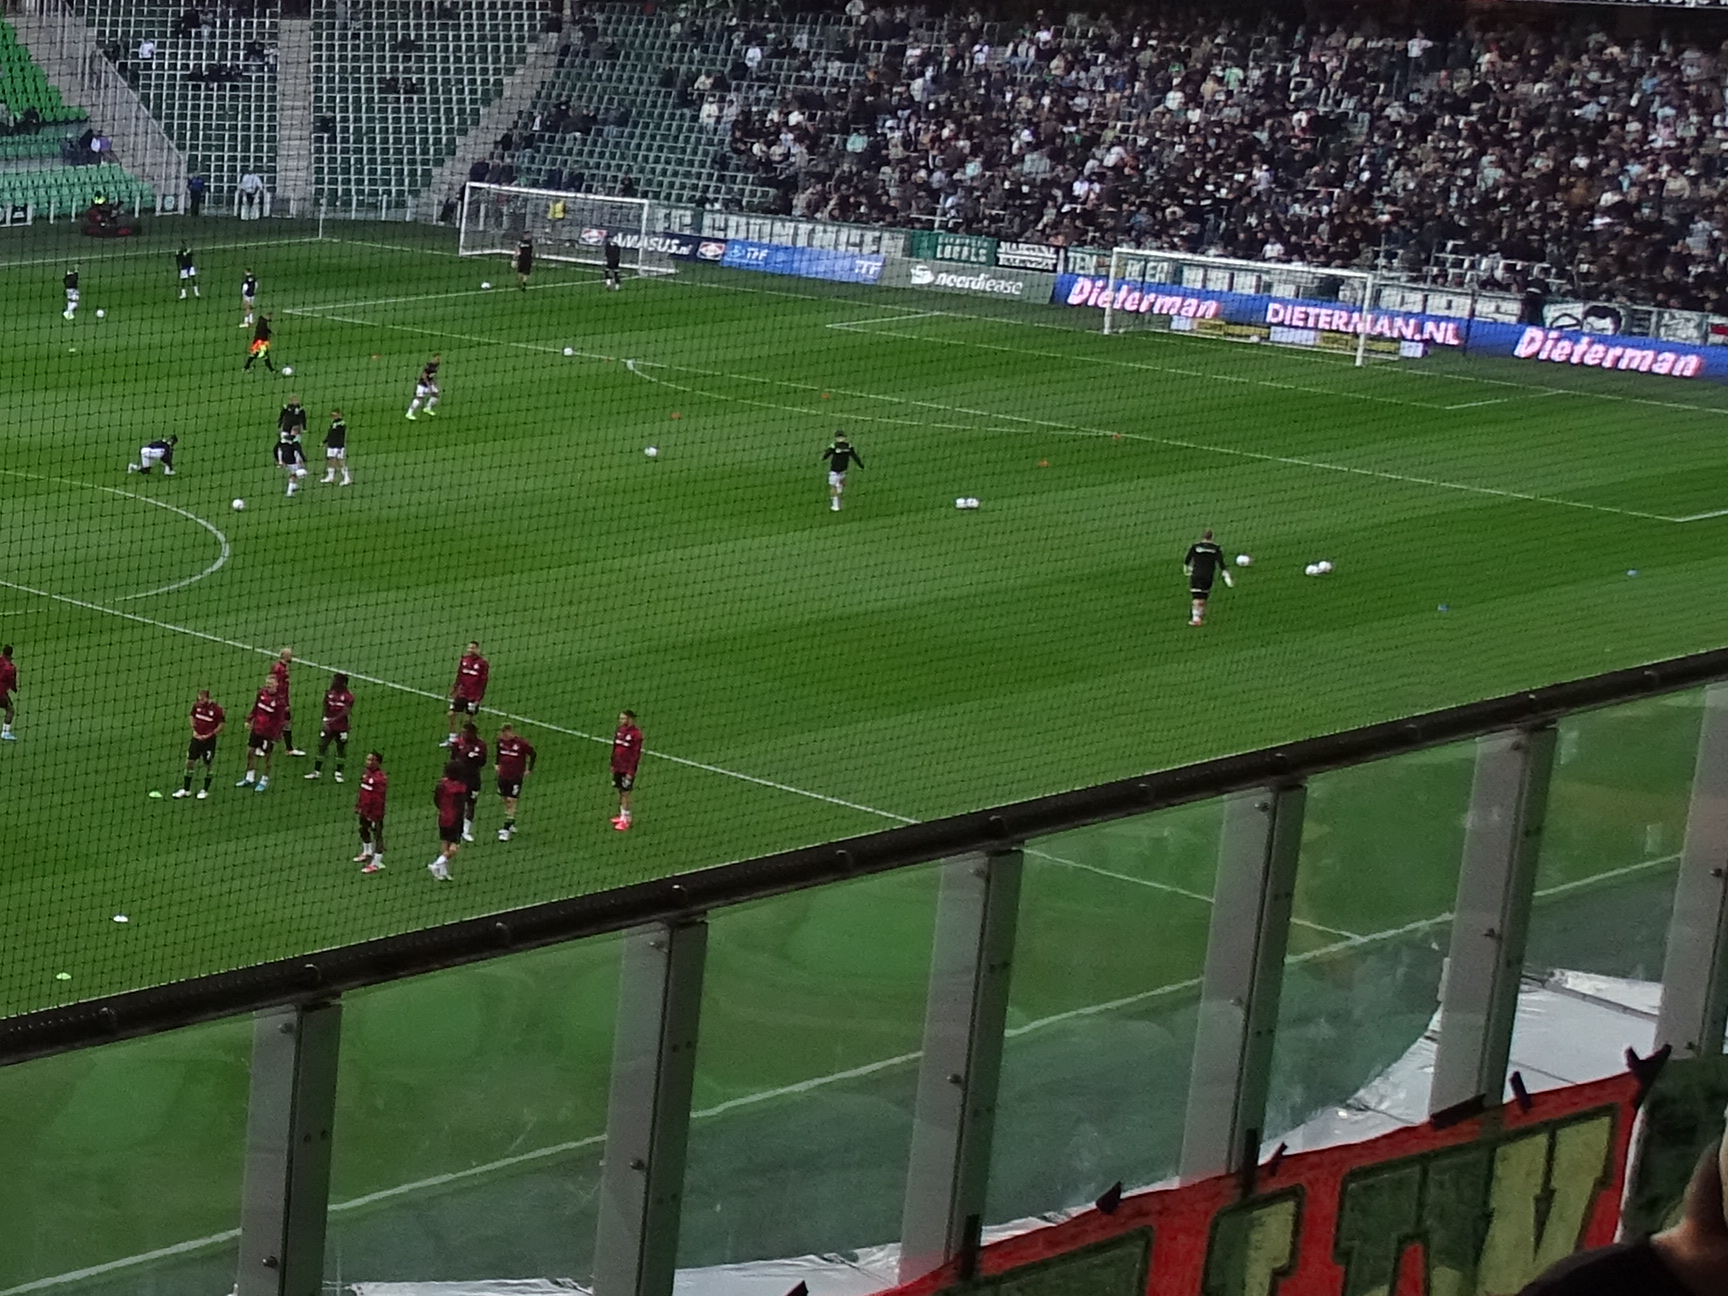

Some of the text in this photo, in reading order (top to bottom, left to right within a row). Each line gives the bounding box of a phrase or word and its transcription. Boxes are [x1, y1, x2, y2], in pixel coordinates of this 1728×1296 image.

[1067, 276, 1221, 319] Dieterman
[1266, 302, 1464, 346] DIETERMAN.NL
[1513, 326, 1704, 378] Dieterman
